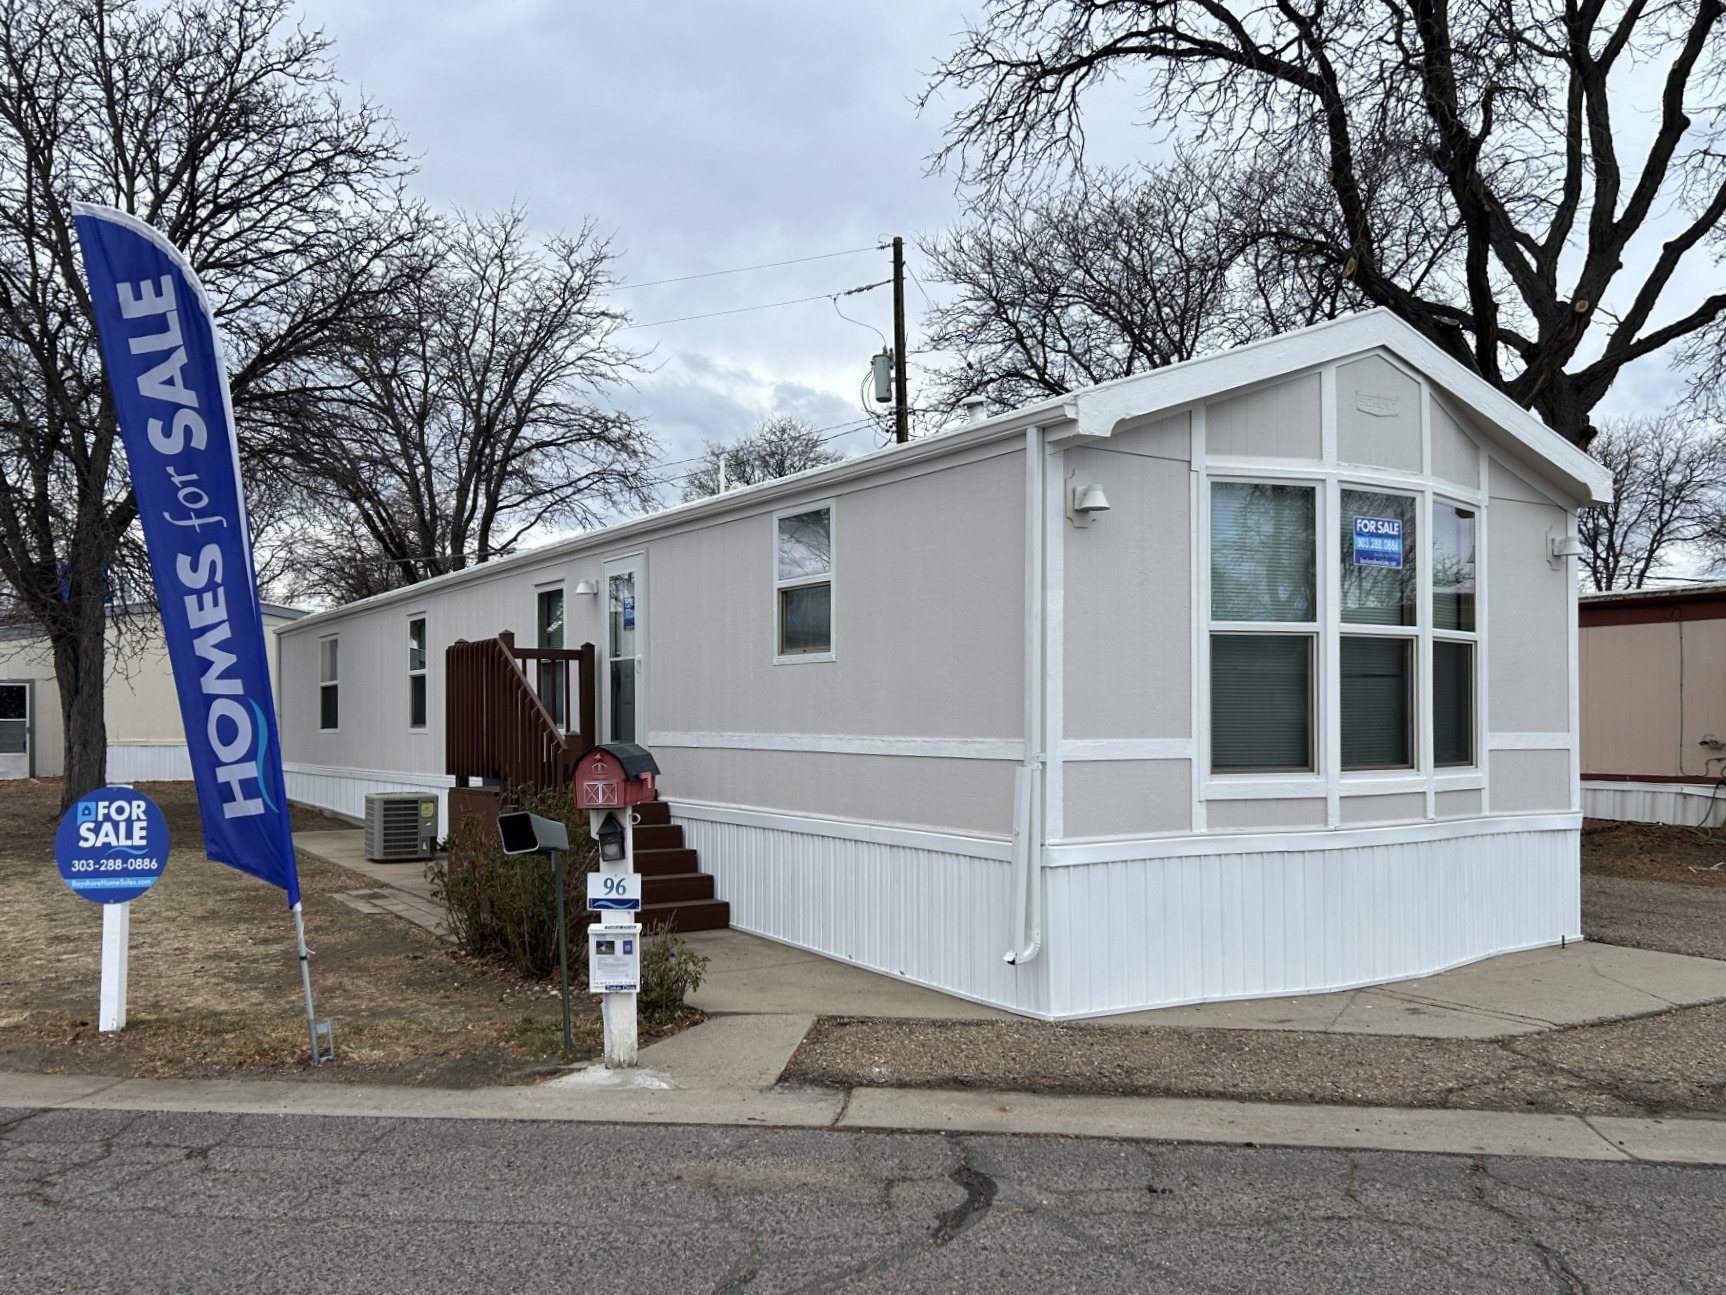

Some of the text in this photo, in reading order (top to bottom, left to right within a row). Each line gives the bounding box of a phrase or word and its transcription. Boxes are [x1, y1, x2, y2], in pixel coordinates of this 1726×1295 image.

[1356, 519, 1399, 535] FOR SALE
[116, 274, 265, 819] HOMES for SALE
[97, 800, 147, 821] FOR
[78, 821, 148, 848] SALE
[71, 858, 158, 872] 303-288-0886
[603, 877, 627, 896] 96
